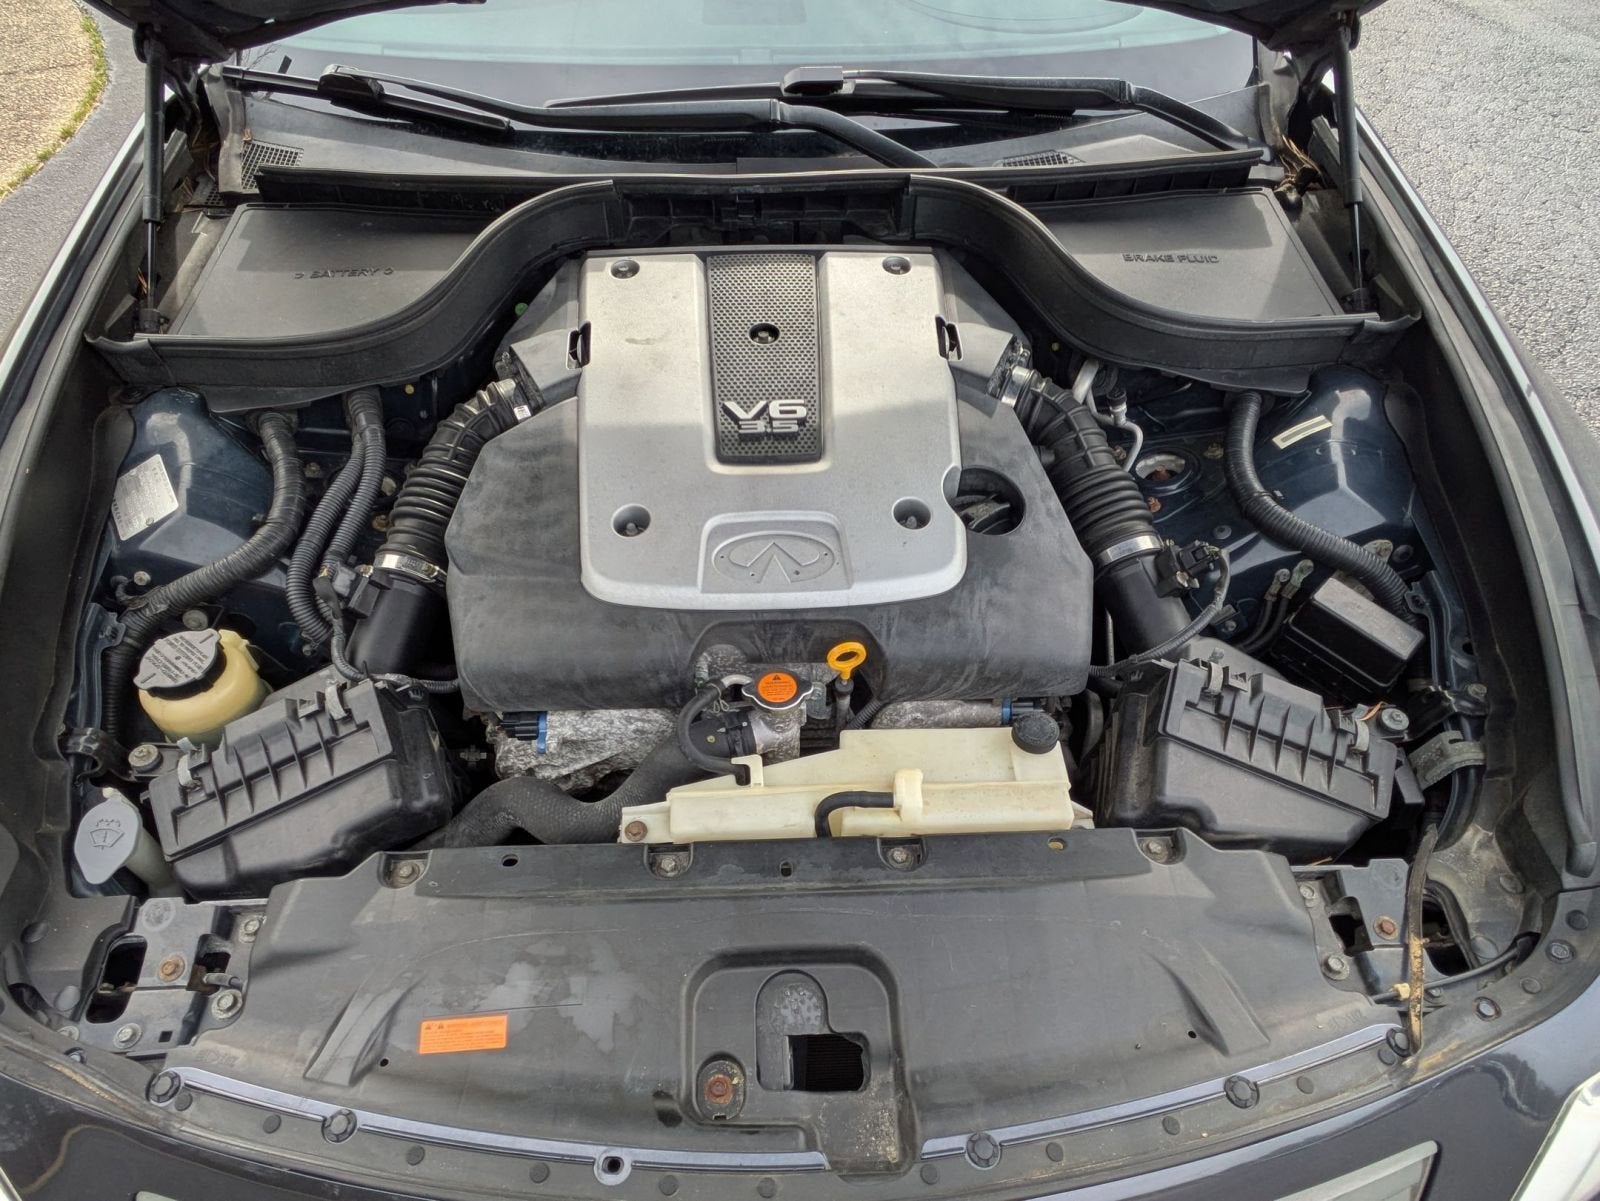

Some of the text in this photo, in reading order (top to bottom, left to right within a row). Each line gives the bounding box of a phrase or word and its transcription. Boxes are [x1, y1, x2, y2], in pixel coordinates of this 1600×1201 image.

[1122, 253, 1175, 263] BRAKE
[310, 267, 380, 279] BATTERY
[723, 400, 807, 420] V6
[739, 420, 799, 433] 3.5
